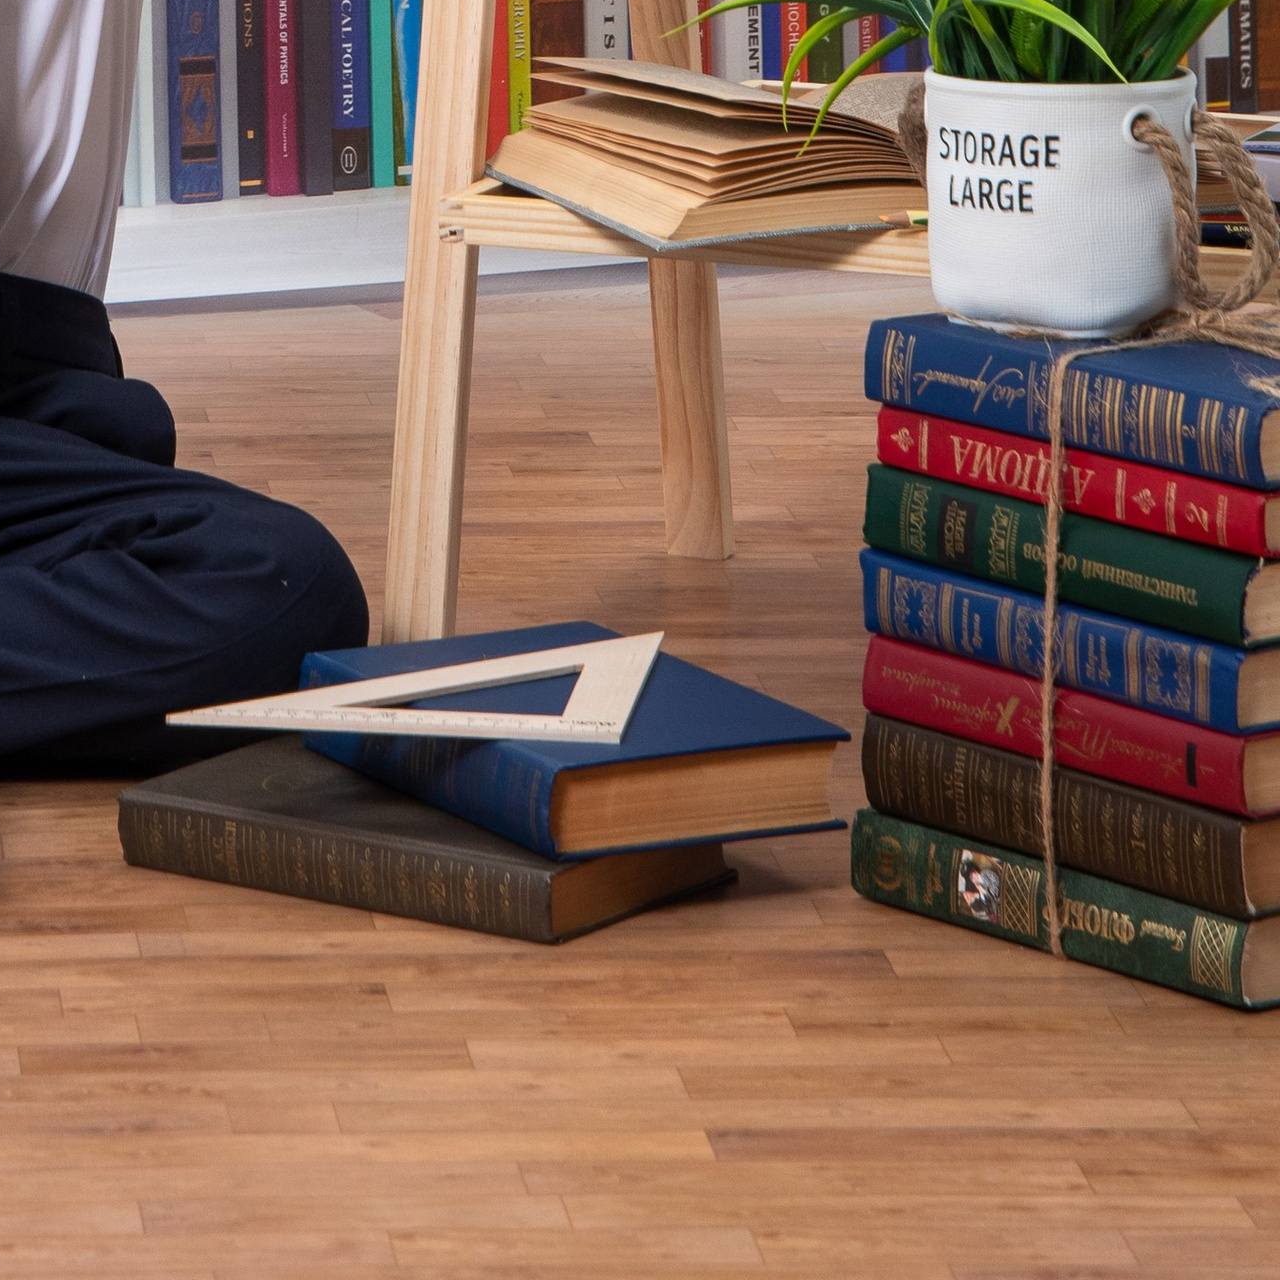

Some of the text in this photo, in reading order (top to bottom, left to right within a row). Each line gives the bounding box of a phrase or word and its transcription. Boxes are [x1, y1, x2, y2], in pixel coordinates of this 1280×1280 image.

[279, 32, 288, 46] OF
[279, 49, 288, 85] PHYSICS
[342, 42, 355, 119] POETRY
[939, 126, 1061, 170] STORAGE
[948, 175, 1035, 215] LARGE
[1022, 541, 1078, 571] ОСРОВ
